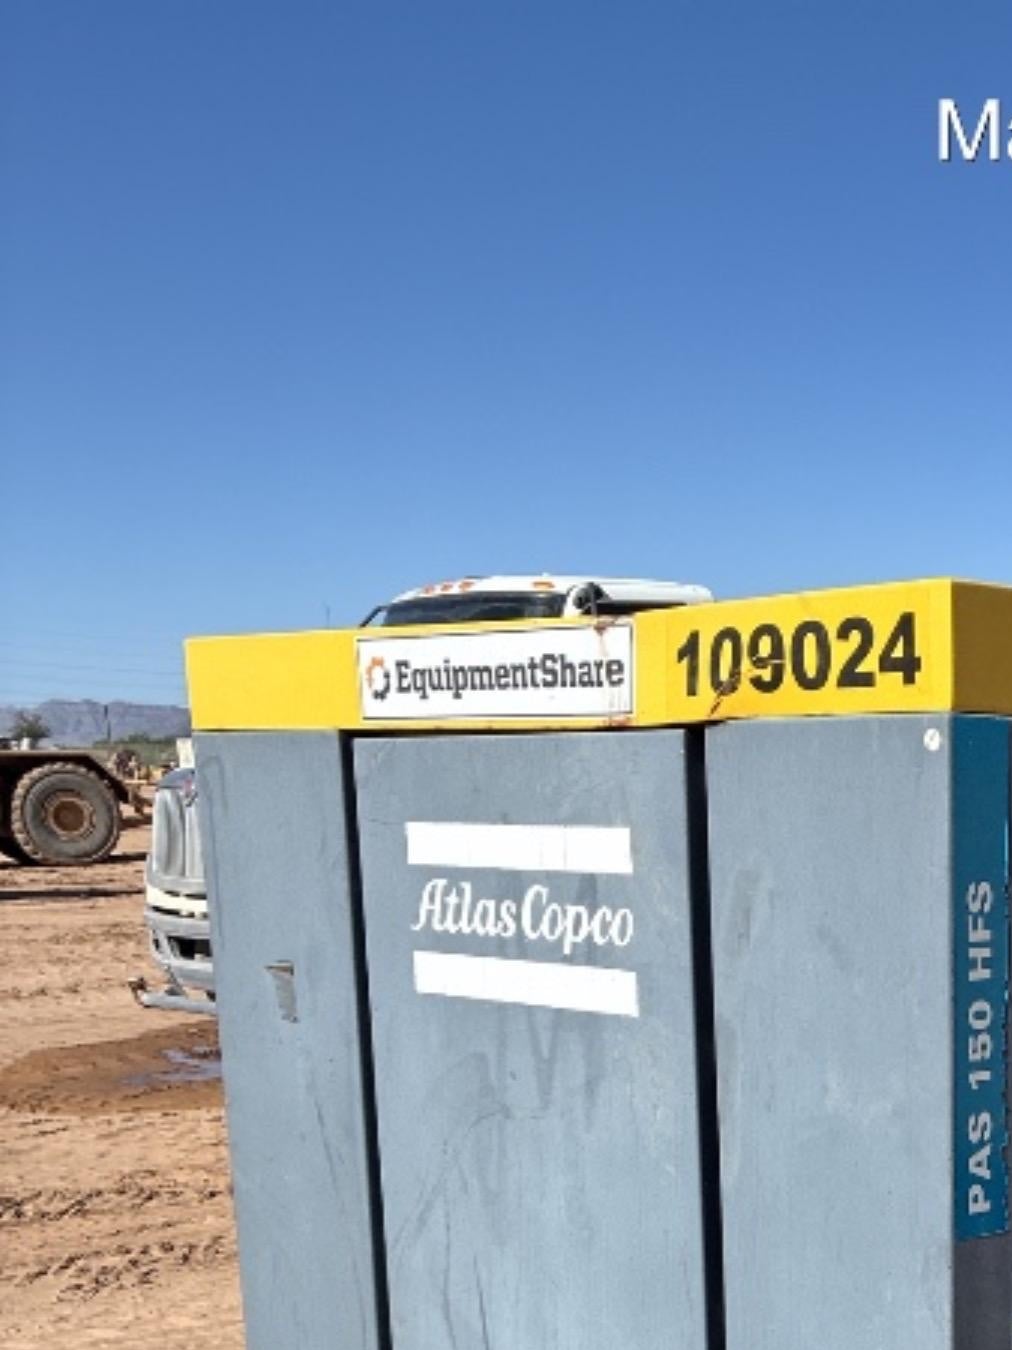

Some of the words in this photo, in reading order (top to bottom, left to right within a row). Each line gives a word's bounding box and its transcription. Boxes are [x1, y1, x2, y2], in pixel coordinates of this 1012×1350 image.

[395, 652, 625, 699] EquipmentShare
[676, 611, 922, 698] 109024
[410, 878, 517, 938] Atlas
[521, 884, 634, 955] Copco
[966, 880, 994, 983] HFS
[968, 999, 994, 1091] 150
[968, 1111, 993, 1216] PAS
